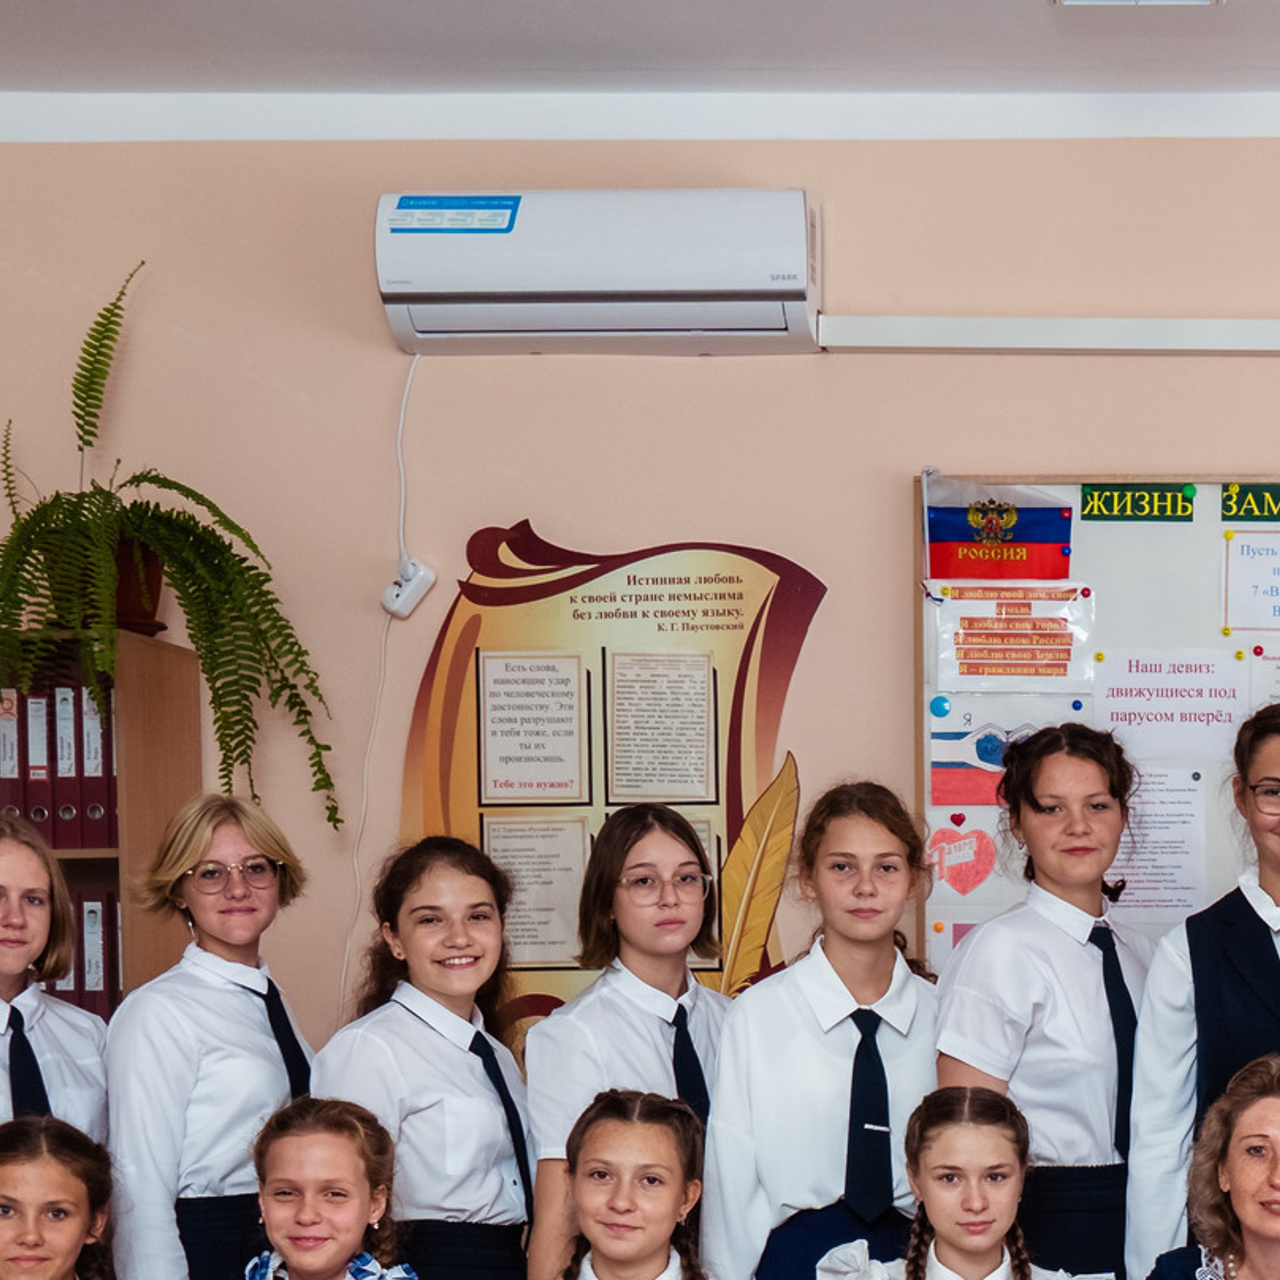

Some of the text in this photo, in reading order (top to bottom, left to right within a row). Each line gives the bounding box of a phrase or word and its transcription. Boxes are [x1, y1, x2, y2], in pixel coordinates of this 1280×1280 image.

[1081, 491, 1193, 516] ЖИЗНЬ
[958, 547, 1027, 560] РОССИЯ
[1240, 544, 1277, 558] Пусть
[626, 573, 743, 585] Истинная любовь
[1252, 585, 1259, 596] 7
[569, 591, 743, 604] к своей стране немыслима
[572, 608, 743, 620] без любви к своему языку.
[657, 622, 744, 632] К. Г. Паустовский
[505, 662, 527, 672] Есть
[1128, 659, 1215, 675] Наш девиз:
[1105, 687, 1237, 701] движущиеся под
[490, 716, 518, 724] слова
[962, 712, 972, 726] Я
[1109, 710, 1233, 726] парусом вперёд
[493, 779, 575, 791] Тебе это нужно?
